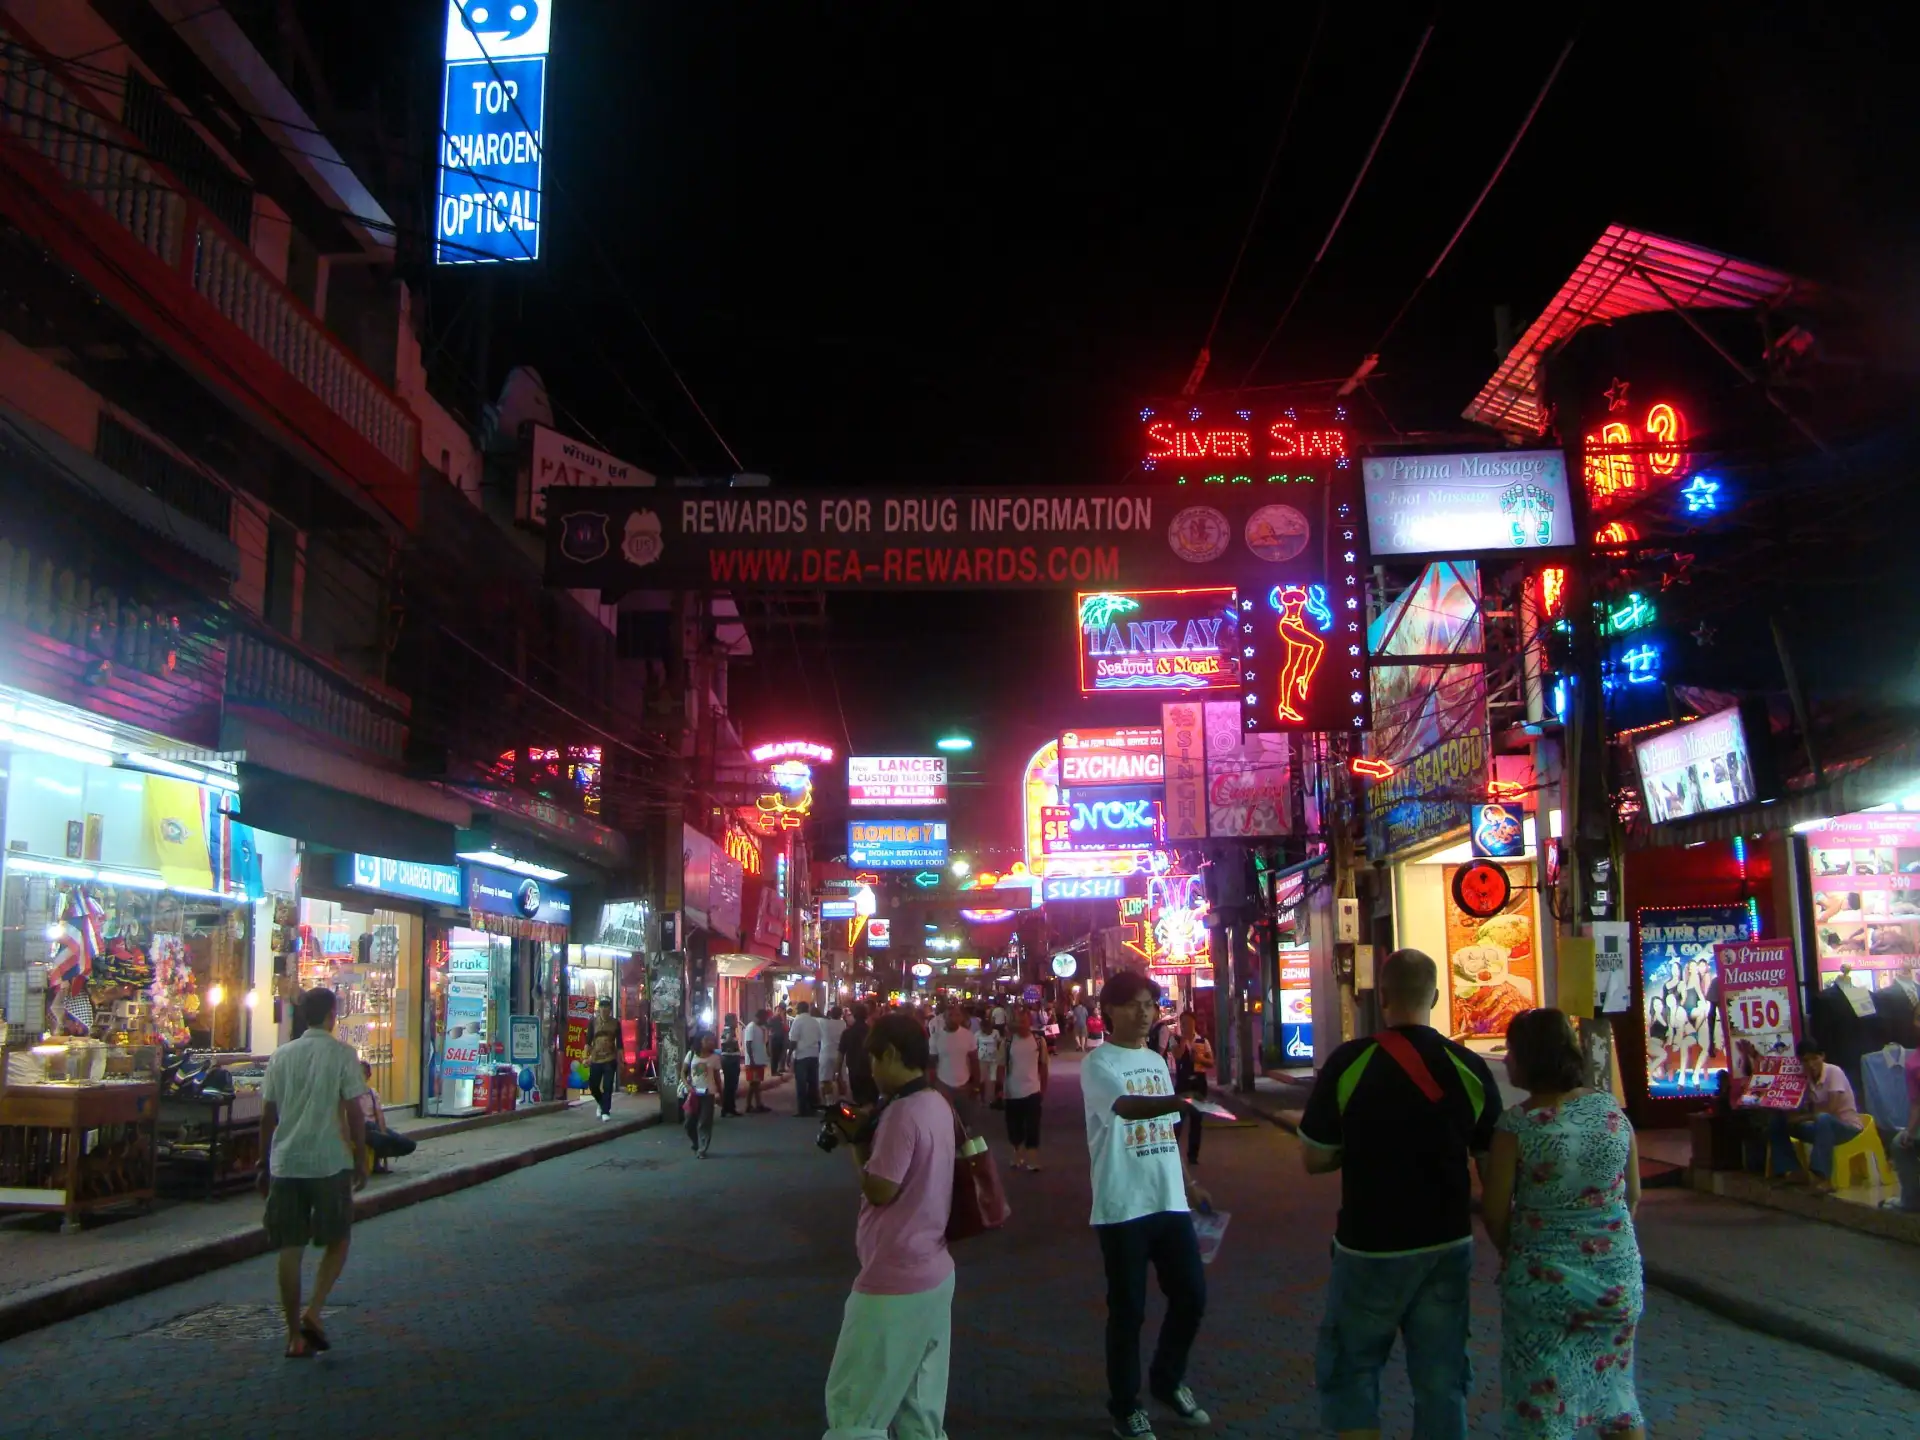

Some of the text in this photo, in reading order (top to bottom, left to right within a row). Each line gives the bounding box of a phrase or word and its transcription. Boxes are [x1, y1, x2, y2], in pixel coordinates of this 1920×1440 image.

[472, 80, 518, 115] TOP
[447, 130, 539, 168] CHAROEN
[442, 190, 536, 236] OPTICAL
[1149, 423, 1345, 458] SILVER STAR
[1389, 456, 1545, 481] Prima Massage
[682, 497, 1152, 533] REWARDS FOR DRUG INFORMATION
[709, 546, 1119, 583] WWW.DEA-REWARDS.COM
[1084, 619, 1222, 655] TANKAY
[1097, 656, 1220, 676] Seafood & Steak
[879, 759, 944, 772] LANCER
[1063, 753, 1164, 779] EXCHANG
[1415, 727, 1482, 796] SEAFOOD
[857, 774, 898, 782] CUSTOM
[894, 785, 935, 797] ALLEN
[1070, 800, 1153, 831] NOK
[852, 826, 934, 843] BOMBAY
[383, 858, 459, 896] TOP CHAROEN OPTICAL
[1047, 878, 1121, 898] SUSHI
[1641, 926, 1697, 943] SILVER
[1697, 925, 1738, 943] STAR
[1680, 943, 1702, 956] GO
[1738, 946, 1784, 964] Prima
[452, 959, 482, 970] drink
[1724, 967, 1786, 986] Massage
[449, 1008, 481, 1018] Eyewear
[1739, 999, 1779, 1029] 150
[568, 1025, 582, 1033] buy
[445, 1047, 477, 1062] SALE
